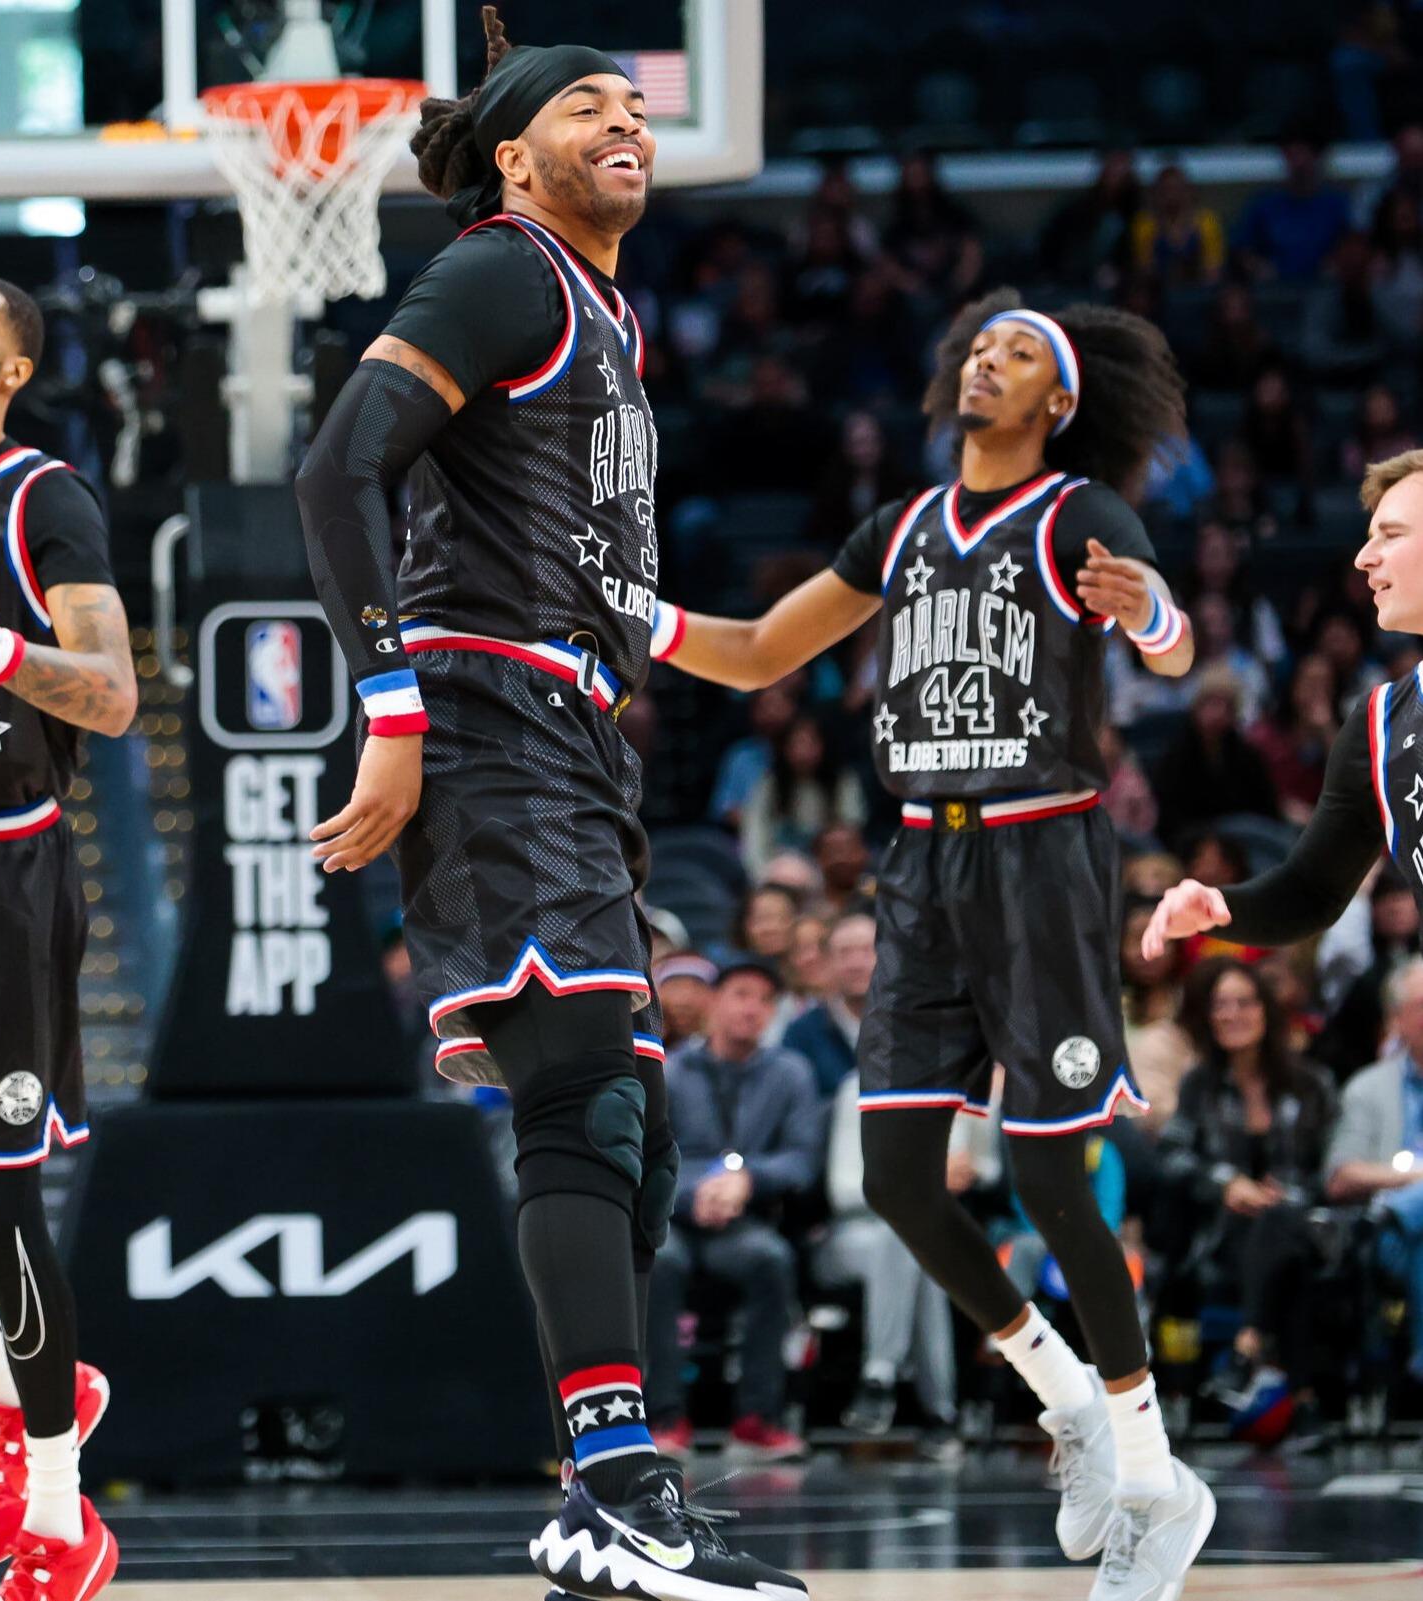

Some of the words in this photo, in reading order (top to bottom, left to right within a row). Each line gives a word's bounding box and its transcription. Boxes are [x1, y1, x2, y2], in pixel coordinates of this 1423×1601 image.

[888, 587, 1036, 690] HARLEM
[918, 665, 996, 737] 44
[222, 755, 326, 843] GET
[888, 738, 1029, 773] GLOBETROTTERS
[224, 844, 329, 929] THE
[225, 931, 332, 1018] APP
[125, 1210, 458, 1300] KIA
